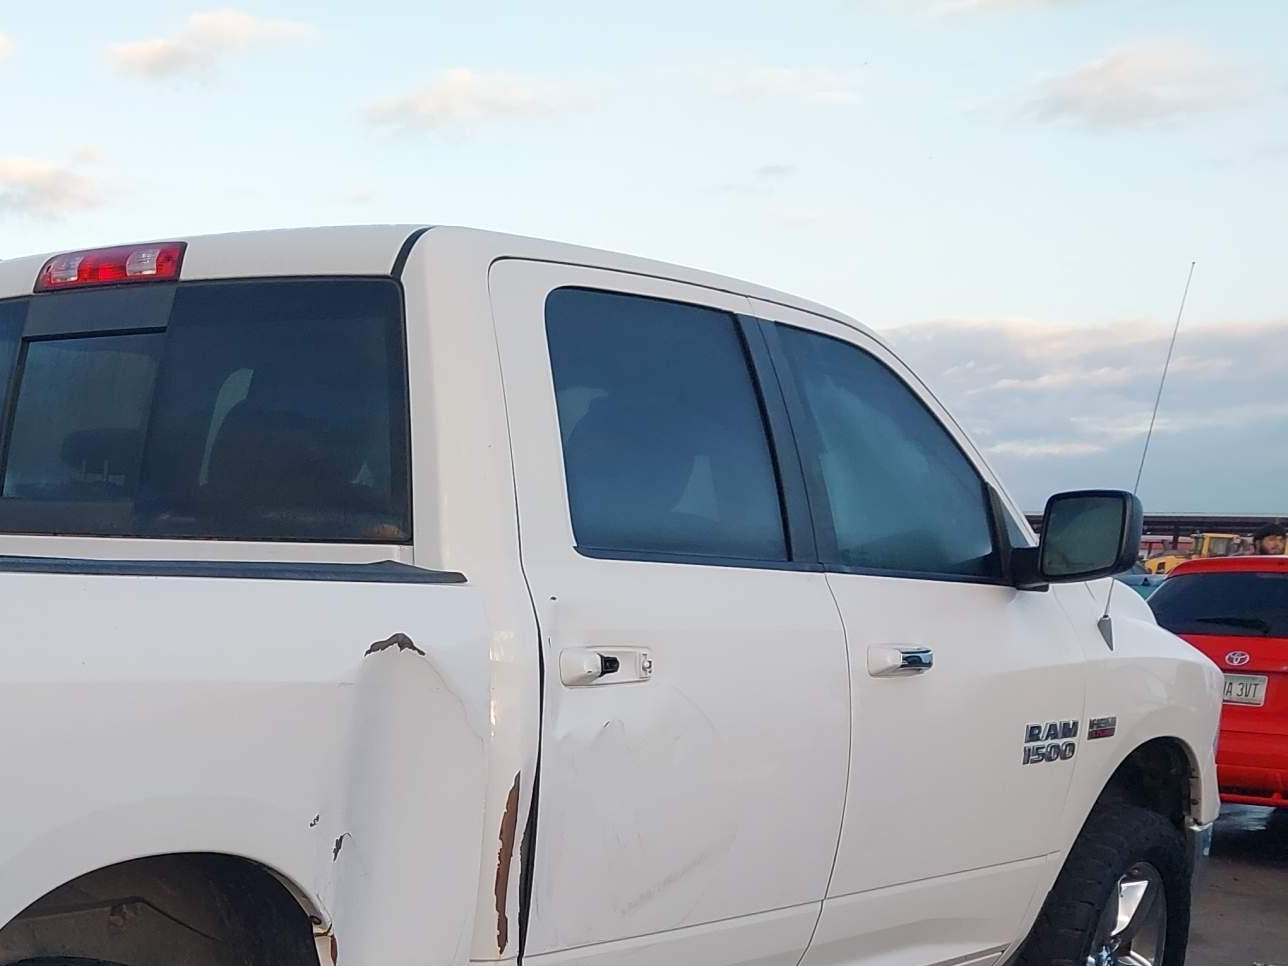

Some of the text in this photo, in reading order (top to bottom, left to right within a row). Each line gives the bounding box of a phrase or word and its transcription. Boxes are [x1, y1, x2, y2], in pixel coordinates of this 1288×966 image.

[1236, 682, 1259, 698] 3VT
[1024, 720, 1079, 743] RAM
[1022, 741, 1076, 765] 1500
